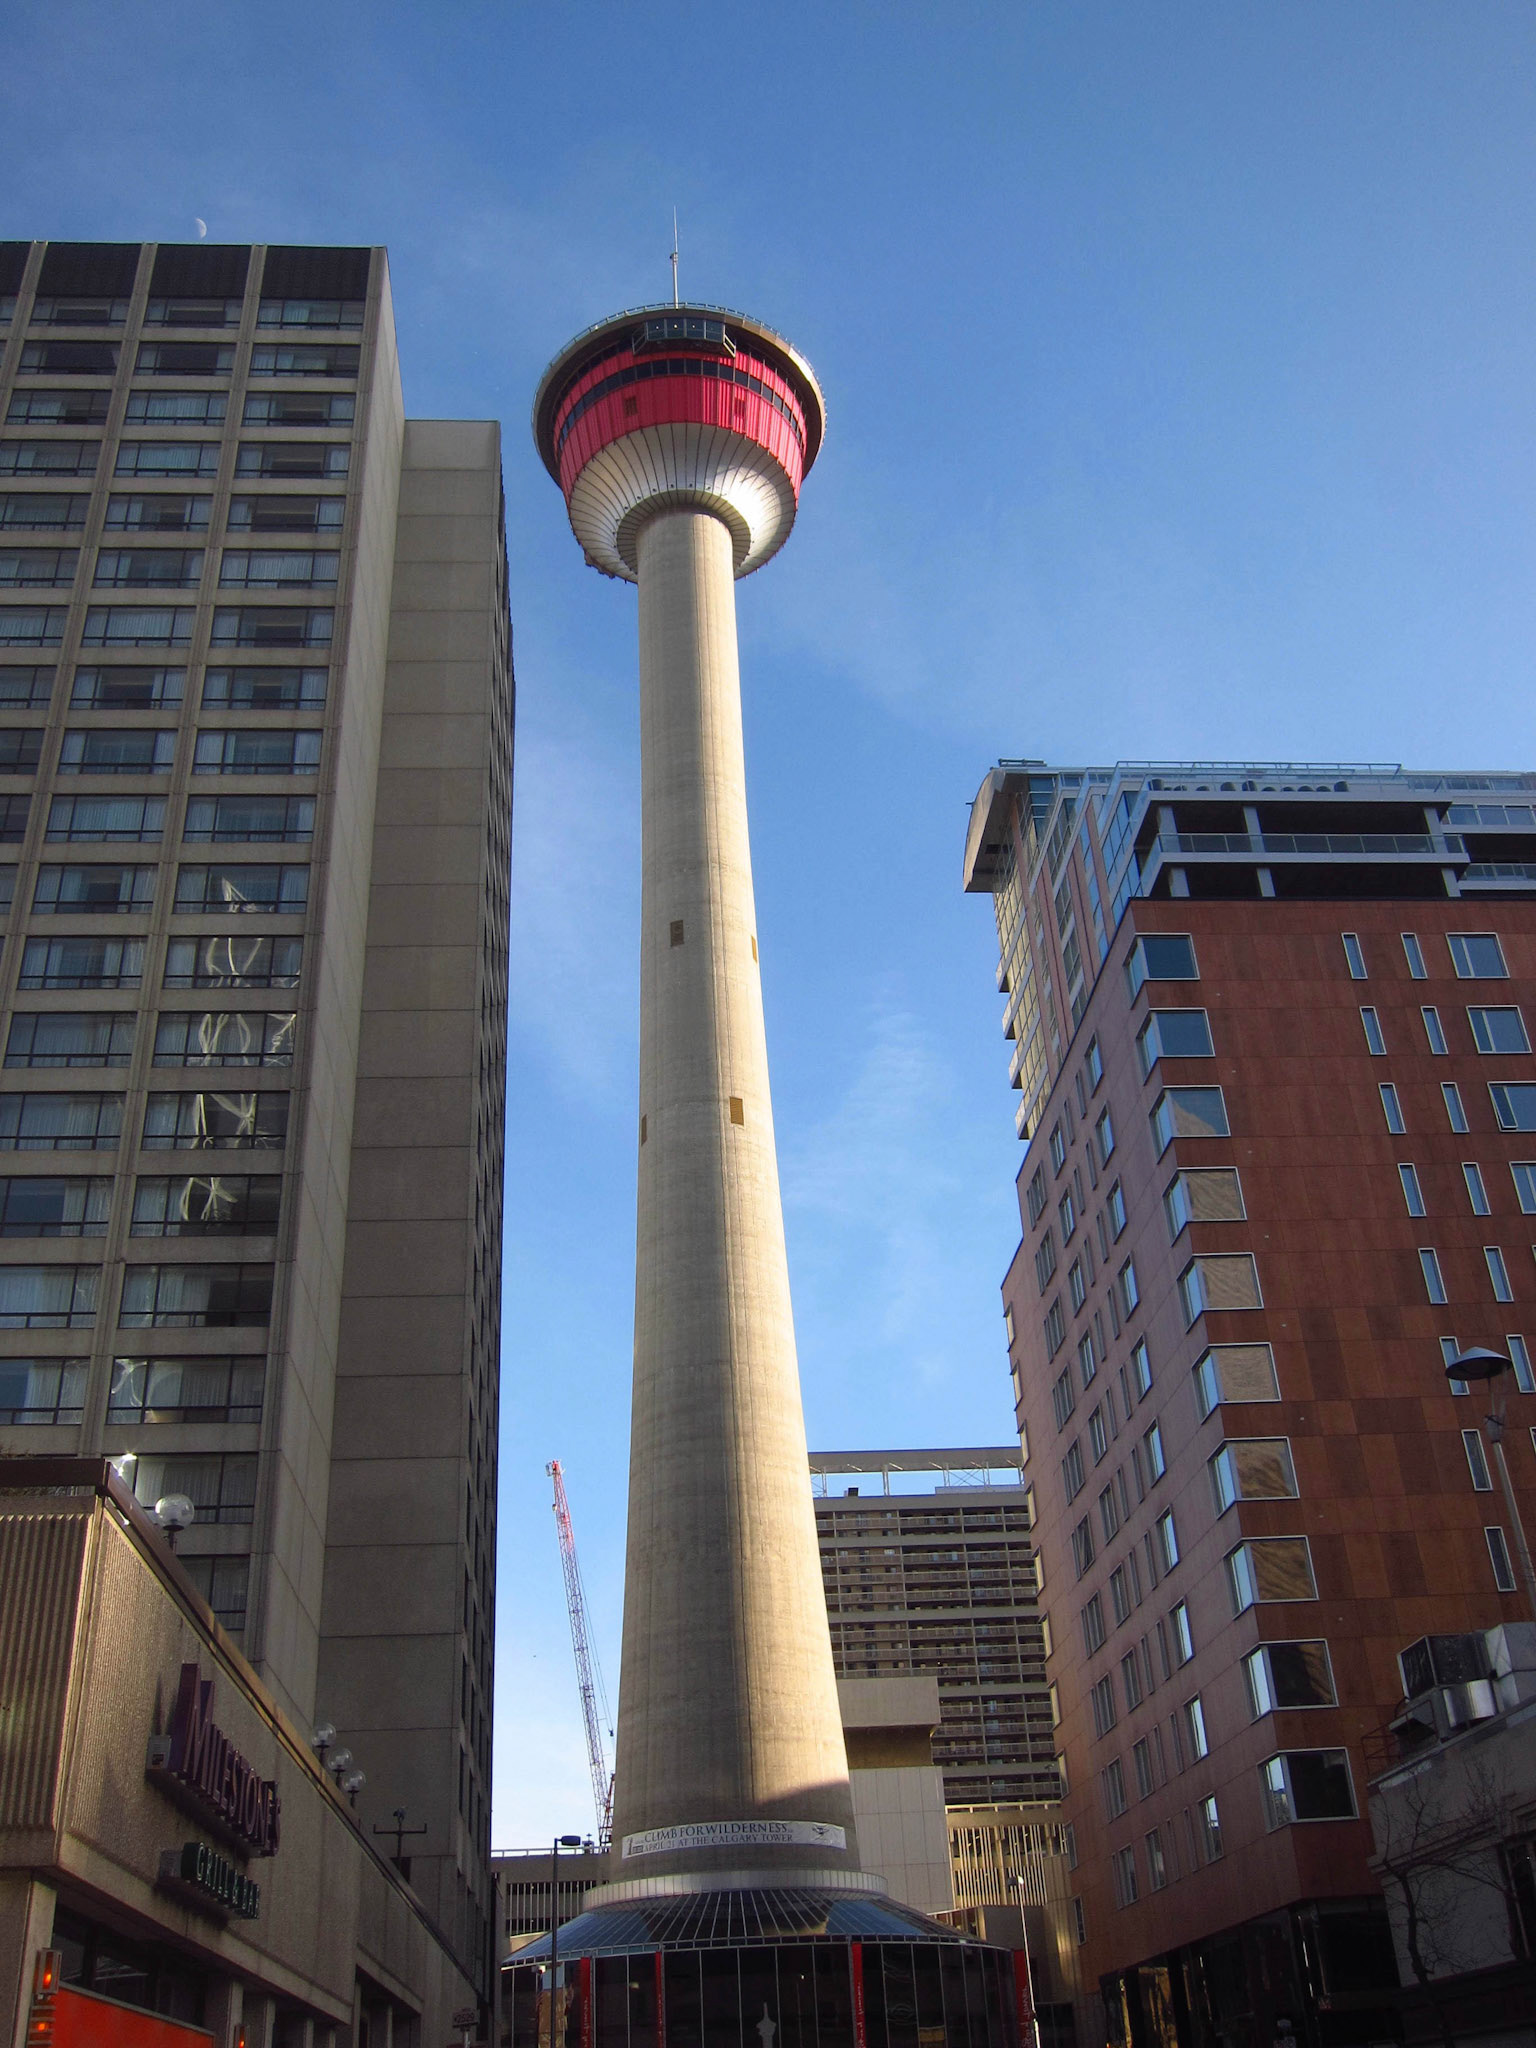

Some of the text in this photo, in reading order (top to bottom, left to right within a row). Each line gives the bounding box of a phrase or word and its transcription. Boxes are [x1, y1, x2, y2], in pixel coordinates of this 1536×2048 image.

[172, 1663, 281, 1857] MILESTONES
[644, 1822, 787, 1842] CLIMB FOR WILDERNESS
[644, 1842, 666, 1852] APRIL
[678, 1838, 689, 1848] AT
[692, 1836, 710, 1846] THE
[711, 1833, 759, 1844] CALGARY
[761, 1832, 793, 1842] TOWER
[190, 1841, 229, 1899] GRILL
